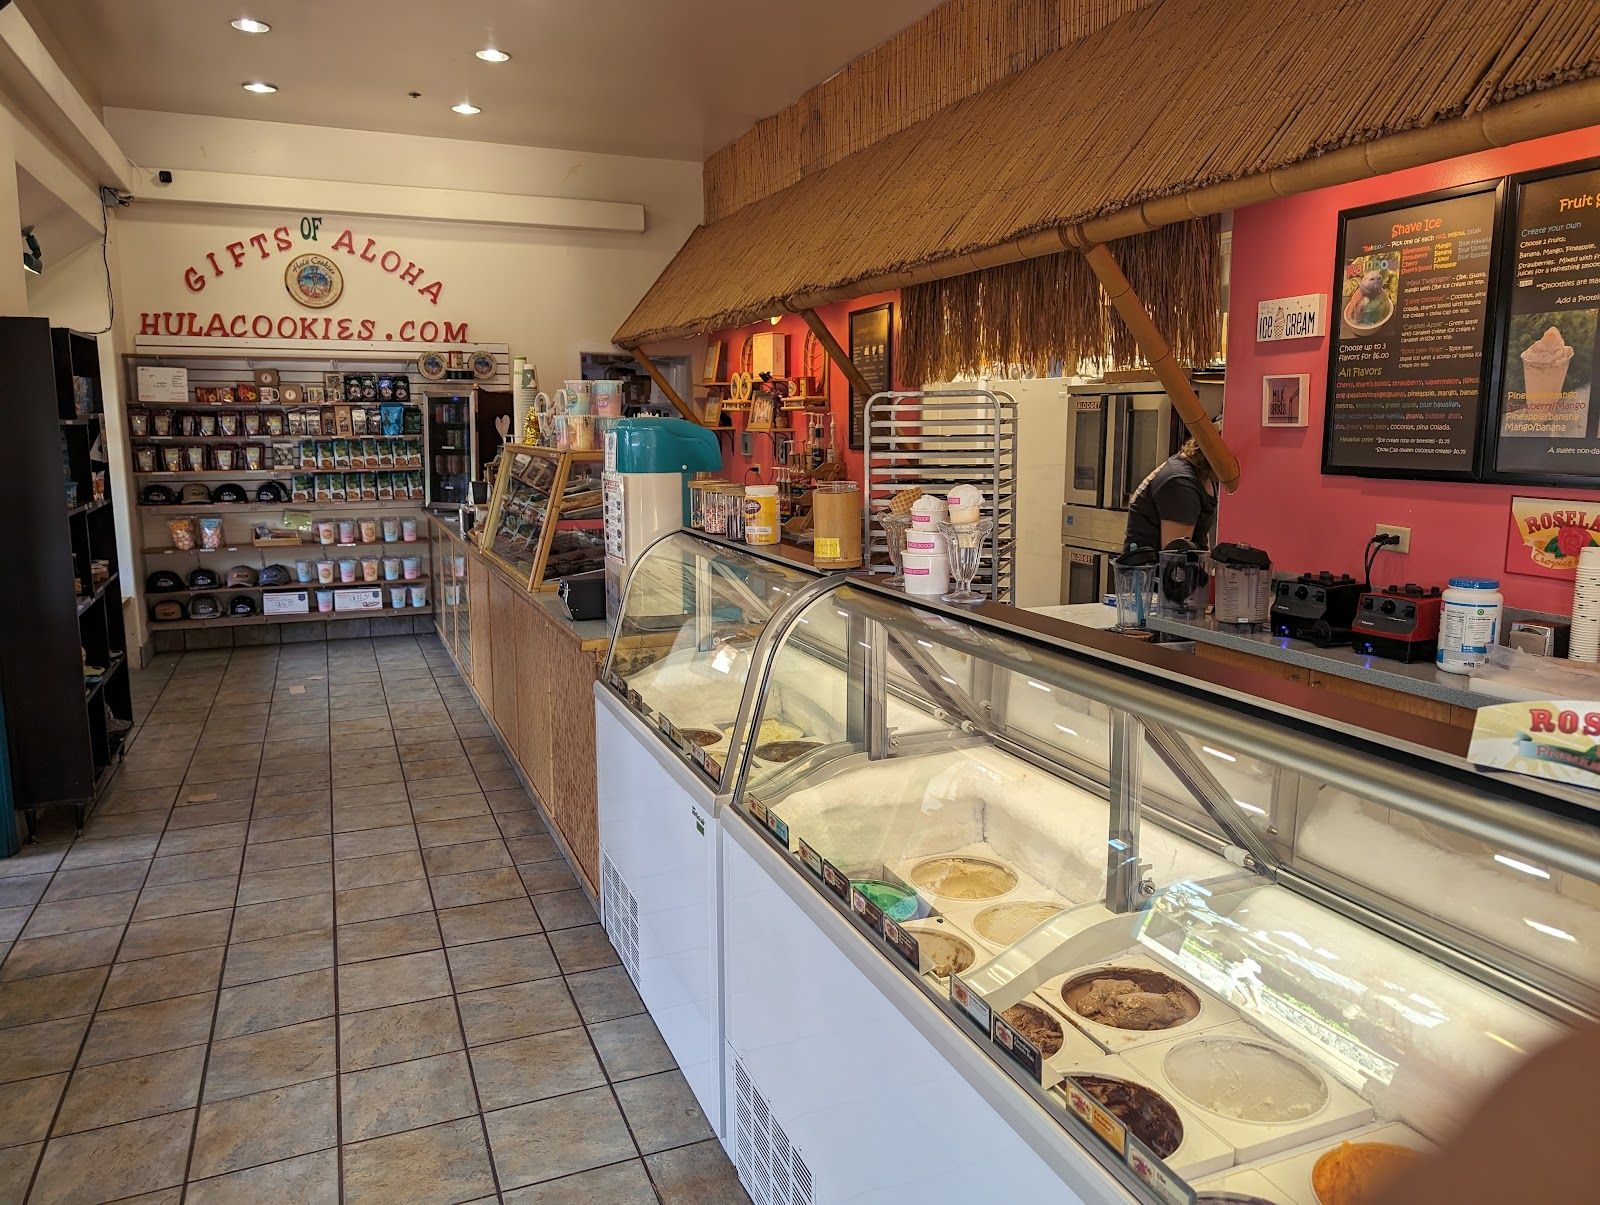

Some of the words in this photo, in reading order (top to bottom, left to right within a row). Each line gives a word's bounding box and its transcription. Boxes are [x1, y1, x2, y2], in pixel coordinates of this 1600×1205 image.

[1559, 194, 1593, 212] Fruit
[1392, 221, 1422, 239] Shave
[1424, 218, 1442, 232] Ice
[1521, 227, 1547, 237] Create
[1547, 224, 1565, 233] your
[1565, 222, 1582, 230] own
[1403, 238, 1413, 246] one
[1421, 234, 1435, 243] each
[1520, 239, 1542, 248] Choose
[1434, 242, 1452, 250] Mango
[1434, 249, 1452, 257] Banana
[184, 226, 293, 293] GIFTS
[300, 217, 322, 241] OF
[332, 229, 443, 305] ALOHA
[1558, 256, 1578, 265] Mixed
[1579, 254, 1593, 262] with
[1516, 269, 1534, 278] juices
[1534, 267, 1544, 275] for
[1549, 264, 1580, 273] refreshing
[1575, 277, 1588, 285] are
[1554, 296, 1571, 304] Add
[139, 311, 469, 343] HULACOOKIES.COM
[1339, 344, 1364, 353] Choose
[1364, 344, 1373, 352] up
[1382, 342, 1387, 350] 3
[1361, 352, 1372, 360] for
[1372, 352, 1390, 360] $6.00
[1337, 367, 1351, 378] All
[1352, 367, 1383, 378] Flavors
[1429, 423, 1452, 431] colada.
[1504, 422, 1567, 432] Mango/banana
[1547, 446, 1555, 454] A
[1529, 708, 1600, 737] ROS
